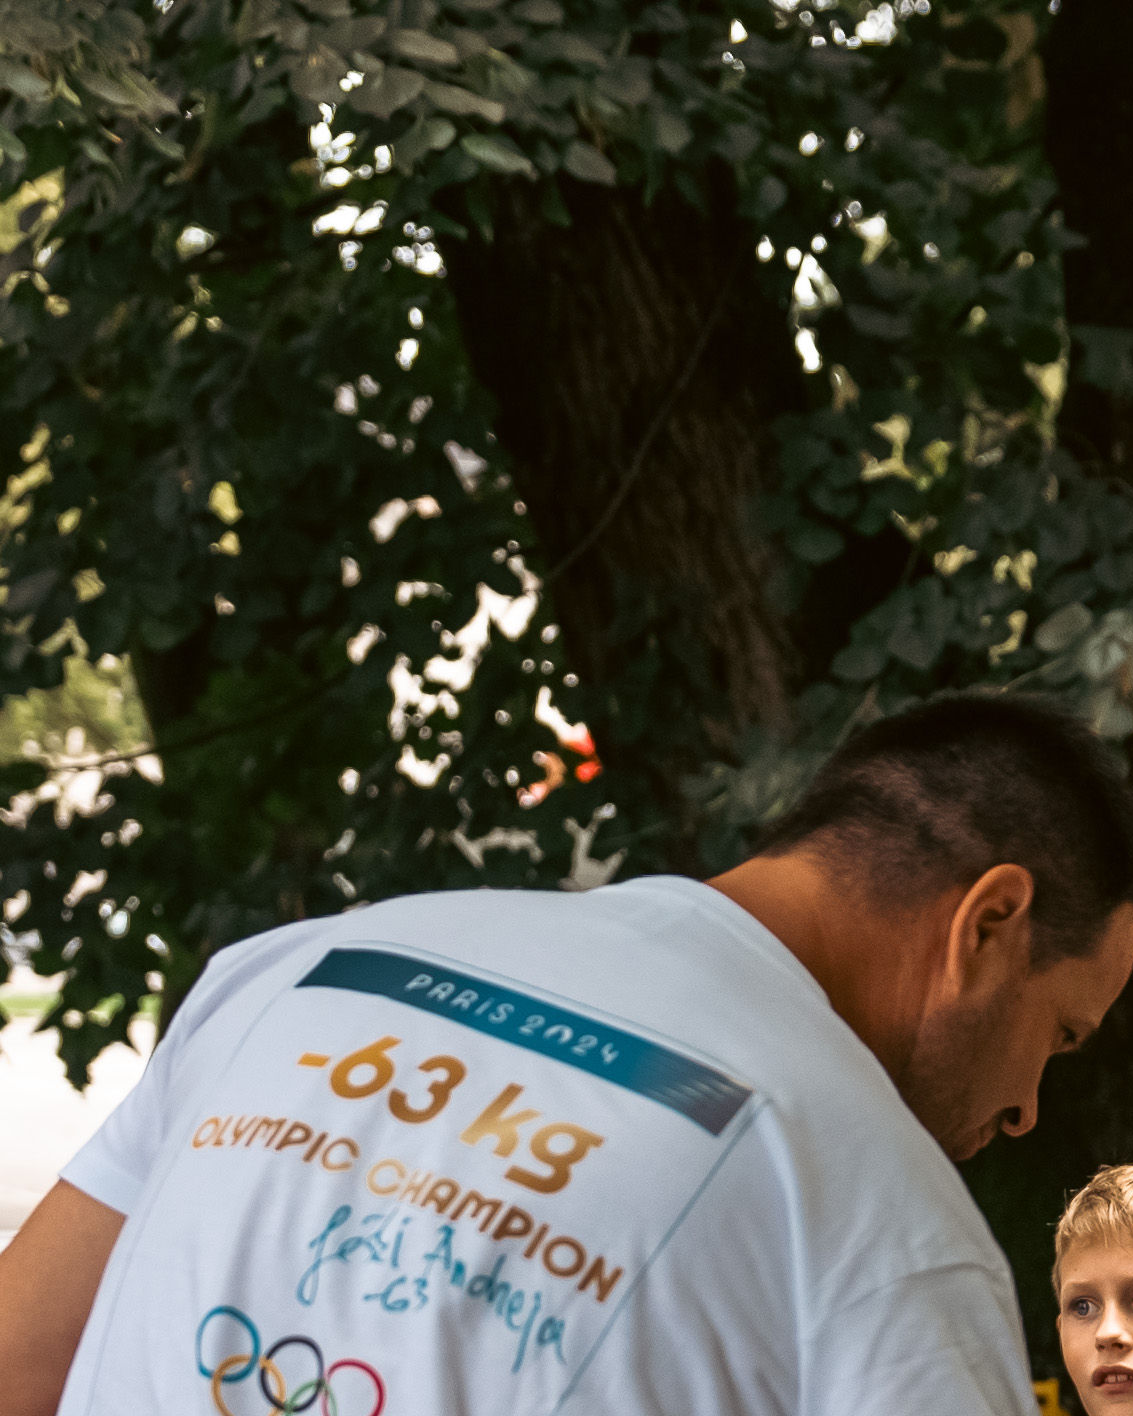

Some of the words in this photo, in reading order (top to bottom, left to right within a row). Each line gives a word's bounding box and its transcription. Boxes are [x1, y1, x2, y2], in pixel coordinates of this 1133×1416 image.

[404, 973, 515, 1024] PARIS
[518, 1014, 619, 1065] 2024
[298, 1036, 466, 1124] -63
[460, 1083, 604, 1194] kg
[191, 1116, 360, 1172] OLYMPIC
[365, 1158, 622, 1302] CHAMPION
